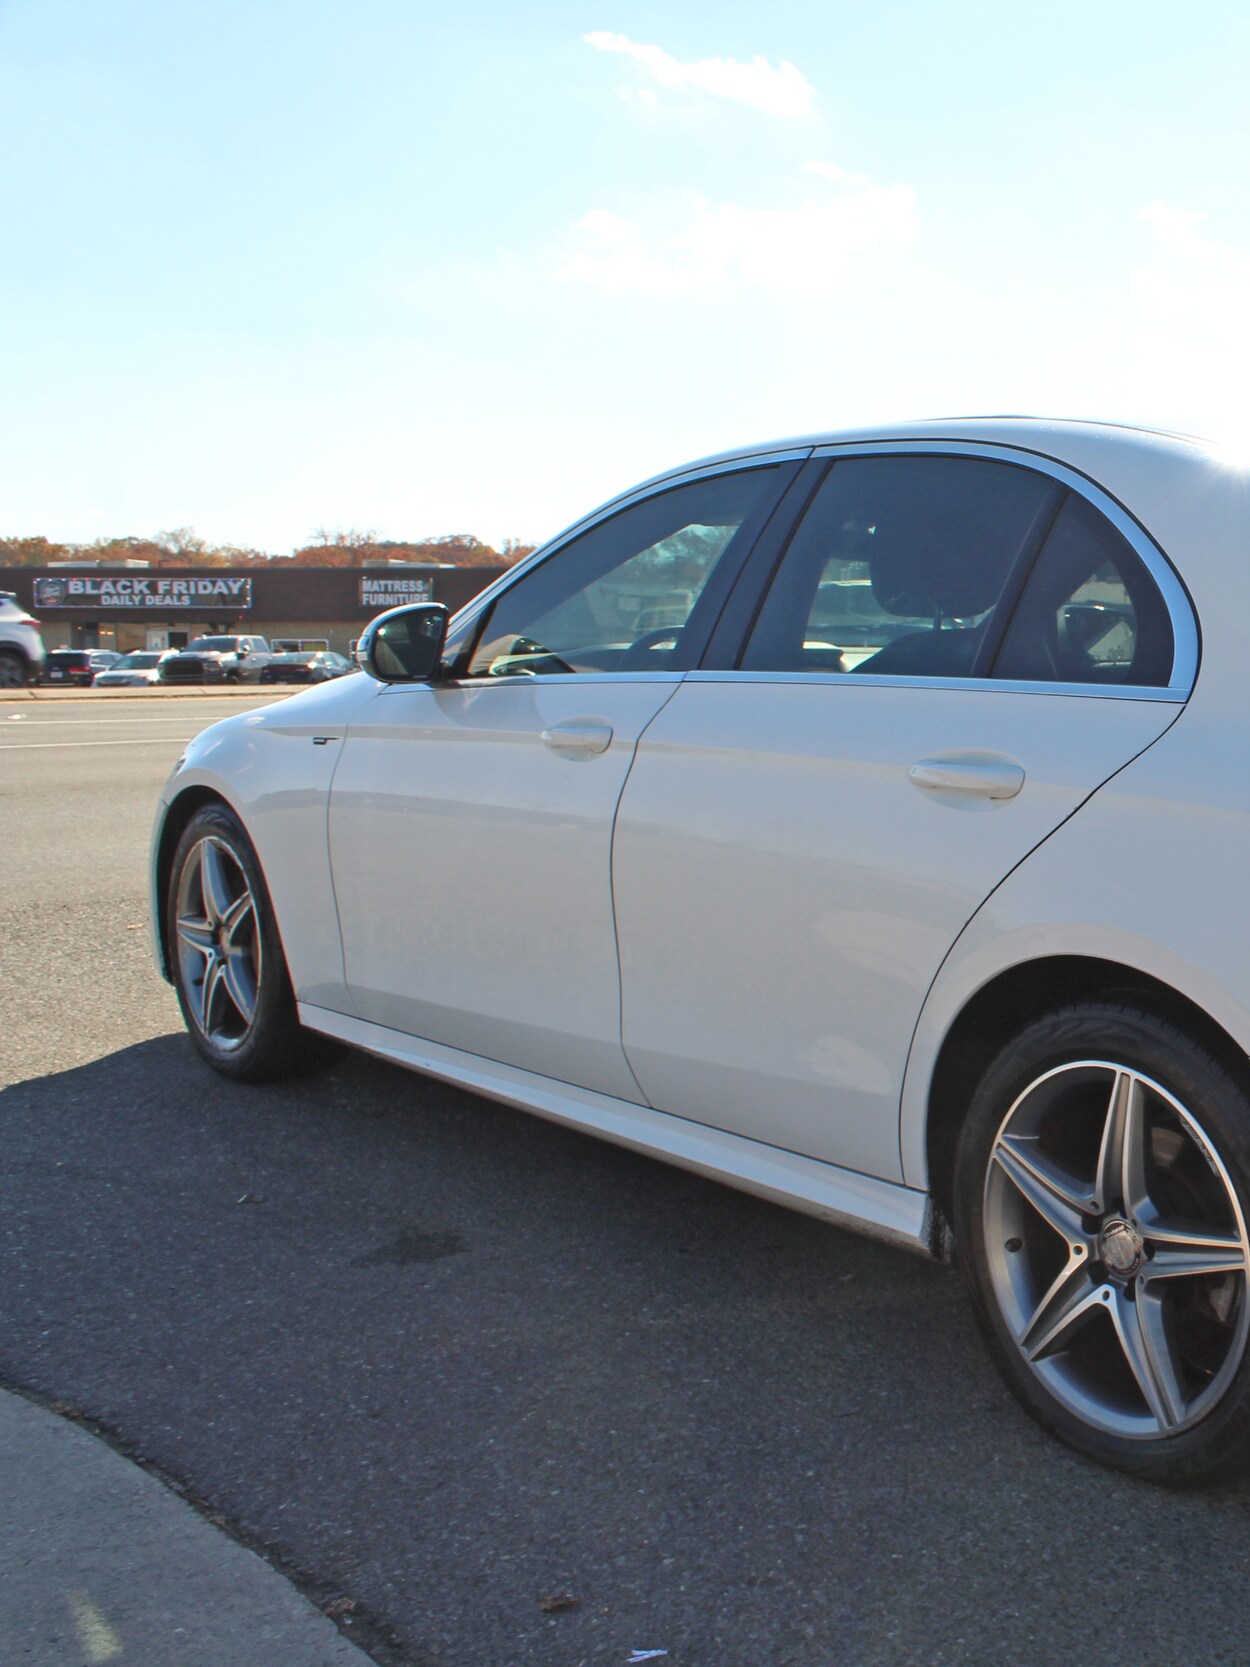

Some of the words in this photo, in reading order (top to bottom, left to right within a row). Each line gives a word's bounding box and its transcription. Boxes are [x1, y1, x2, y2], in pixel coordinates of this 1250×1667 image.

[67, 580, 150, 595] BLACK
[157, 580, 243, 595] FRIDAY
[362, 580, 424, 592] MATTRESS
[101, 595, 142, 606] DAILY
[145, 595, 191, 606] DEALS
[362, 593, 429, 606] FURNITURE
